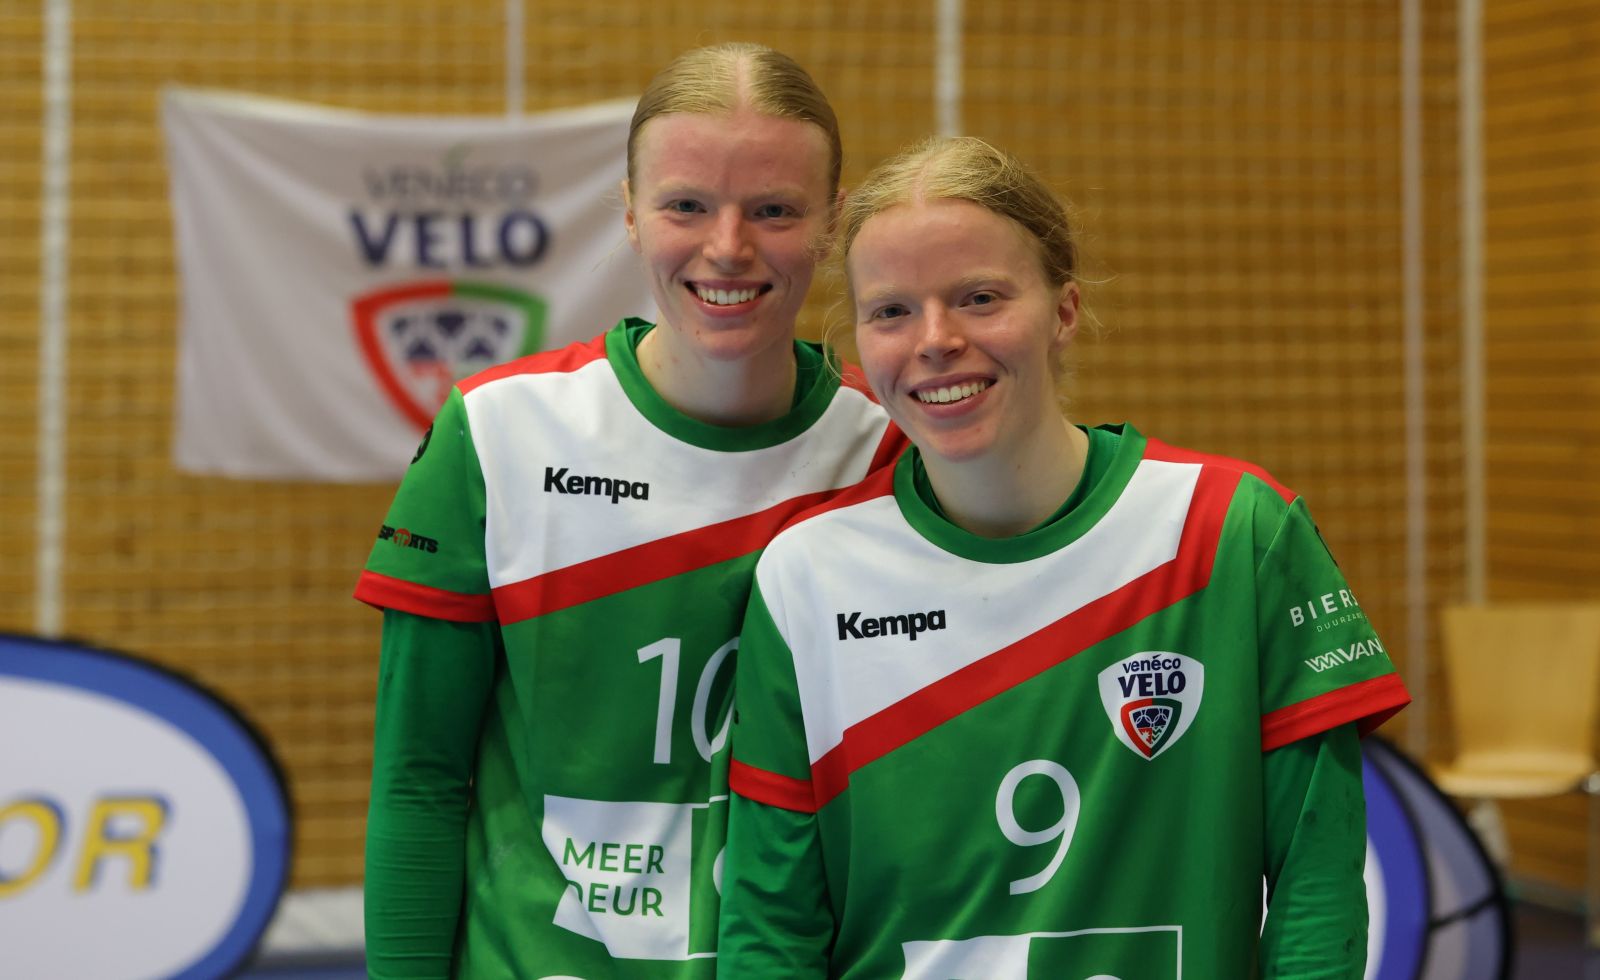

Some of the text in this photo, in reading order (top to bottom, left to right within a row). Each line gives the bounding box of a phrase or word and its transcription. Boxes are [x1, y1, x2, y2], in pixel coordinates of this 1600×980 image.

[350, 211, 550, 268] VELO
[544, 467, 649, 504] Kempa
[837, 610, 947, 641] Kempa
[1122, 653, 1181, 674] venéco
[637, 637, 739, 764] 10
[1117, 670, 1187, 698] VELO
[995, 759, 1081, 896] 9
[562, 837, 665, 874] MEER
